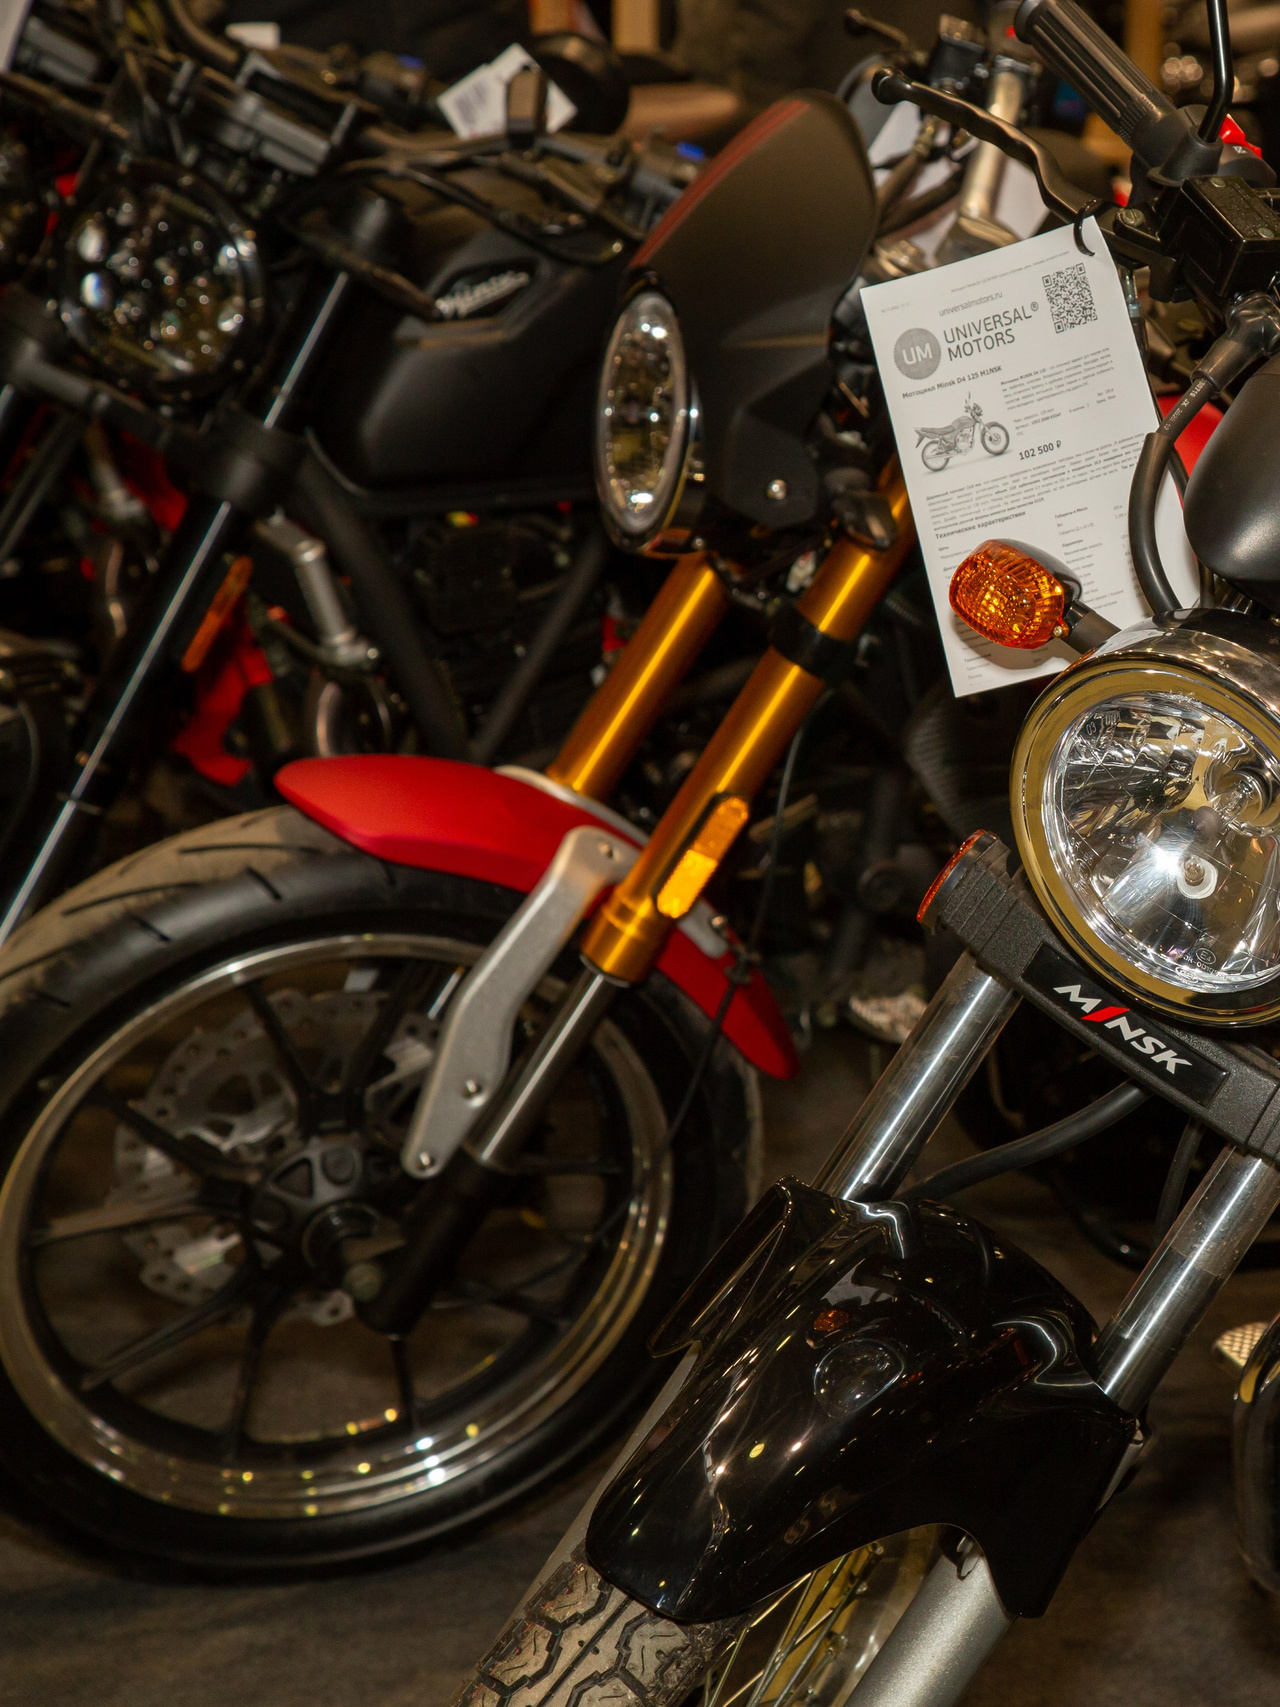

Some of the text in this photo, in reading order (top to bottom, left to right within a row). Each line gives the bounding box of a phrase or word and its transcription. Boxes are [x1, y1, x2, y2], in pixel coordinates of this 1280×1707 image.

[939, 291, 1003, 316] universalmotors.ru
[902, 343, 934, 366] UM
[947, 328, 1015, 362] MOTORS
[902, 385, 936, 399] Мотоцикл
[937, 379, 956, 390] Minsk
[956, 376, 966, 384] D4
[967, 372, 979, 381] 125
[1019, 448, 1036, 461] 102
[1037, 442, 1055, 456] 500
